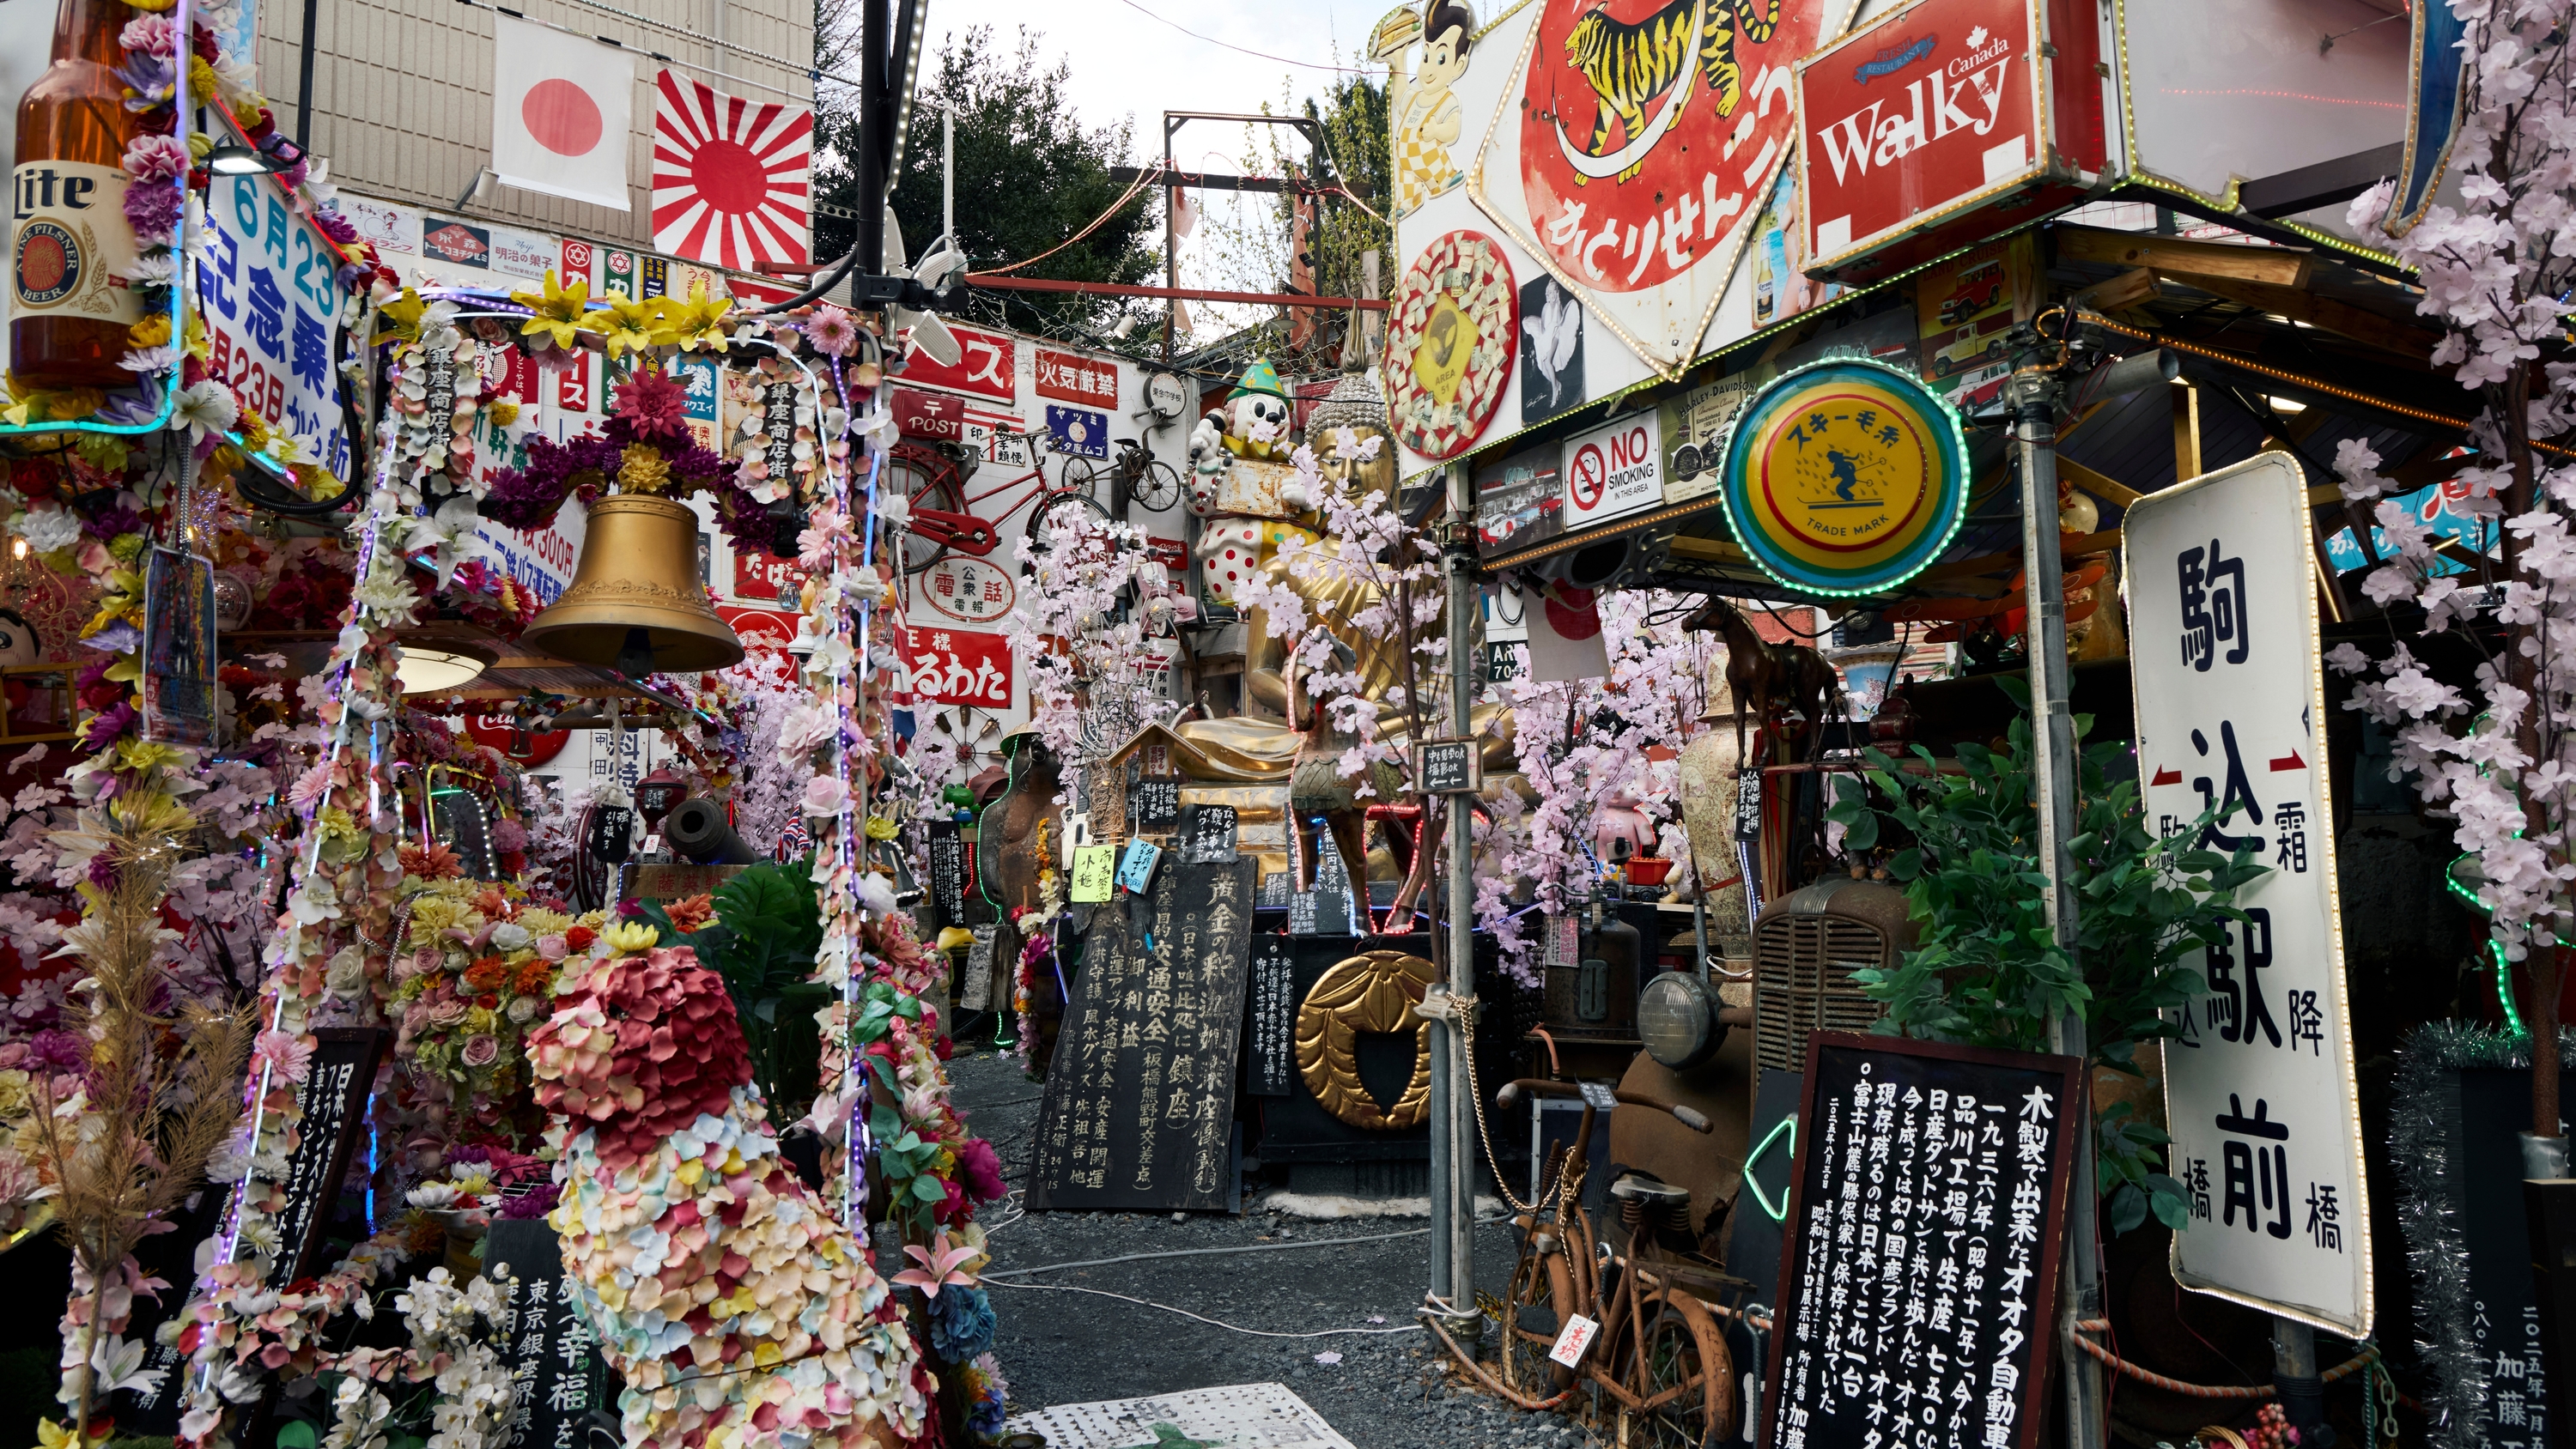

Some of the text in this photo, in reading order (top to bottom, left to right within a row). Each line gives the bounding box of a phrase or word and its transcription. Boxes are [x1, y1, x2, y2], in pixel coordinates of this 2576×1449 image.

[1866, 45, 1922, 74] RESTAURANT
[1876, 39, 1912, 62] FRESH
[1947, 37, 2009, 78] Canada
[1407, 115, 1419, 125] BOY
[1816, 56, 2011, 187] Walky
[14, 168, 97, 220] Lite
[17, 232, 33, 258] FINE
[35, 225, 78, 270] PILSNER
[234, 175, 347, 318] 6月23
[495, 246, 552, 269] 明治の菓子
[23, 287, 64, 301] BEER
[1040, 361, 1115, 397] 火気厳禁
[1435, 369, 1456, 387] AREA
[1441, 384, 1450, 395] 51
[1679, 381, 1757, 418] HARLEY-DAVIDSON
[769, 384, 791, 478] 銀座商店街
[908, 415, 959, 436] POST
[1786, 410, 1900, 456] スキー毛糸
[1611, 426, 1649, 472] NO
[1608, 463, 1655, 490] SMOKING
[1614, 483, 1649, 500] IN THIS AREA
[1807, 513, 1889, 537] TRADE MARK
[936, 573, 1003, 603] 電話
[963, 566, 976, 597] 公衆
[955, 598, 983, 613] 電報
[908, 652, 1007, 701] るわた
[657, 874, 724, 894] 薩英戦
[2177, 538, 2293, 1241] 駒込駅前
[2275, 801, 2343, 1255] 霜降橋
[1795, 1204, 1825, 1343] 昭和レトロ展示場
[1981, 1085, 2054, 1449] 木製で出来たオオタ自動車
[1792, 1349, 1812, 1402] 所有者
[2494, 1350, 2527, 1449] 加藤
